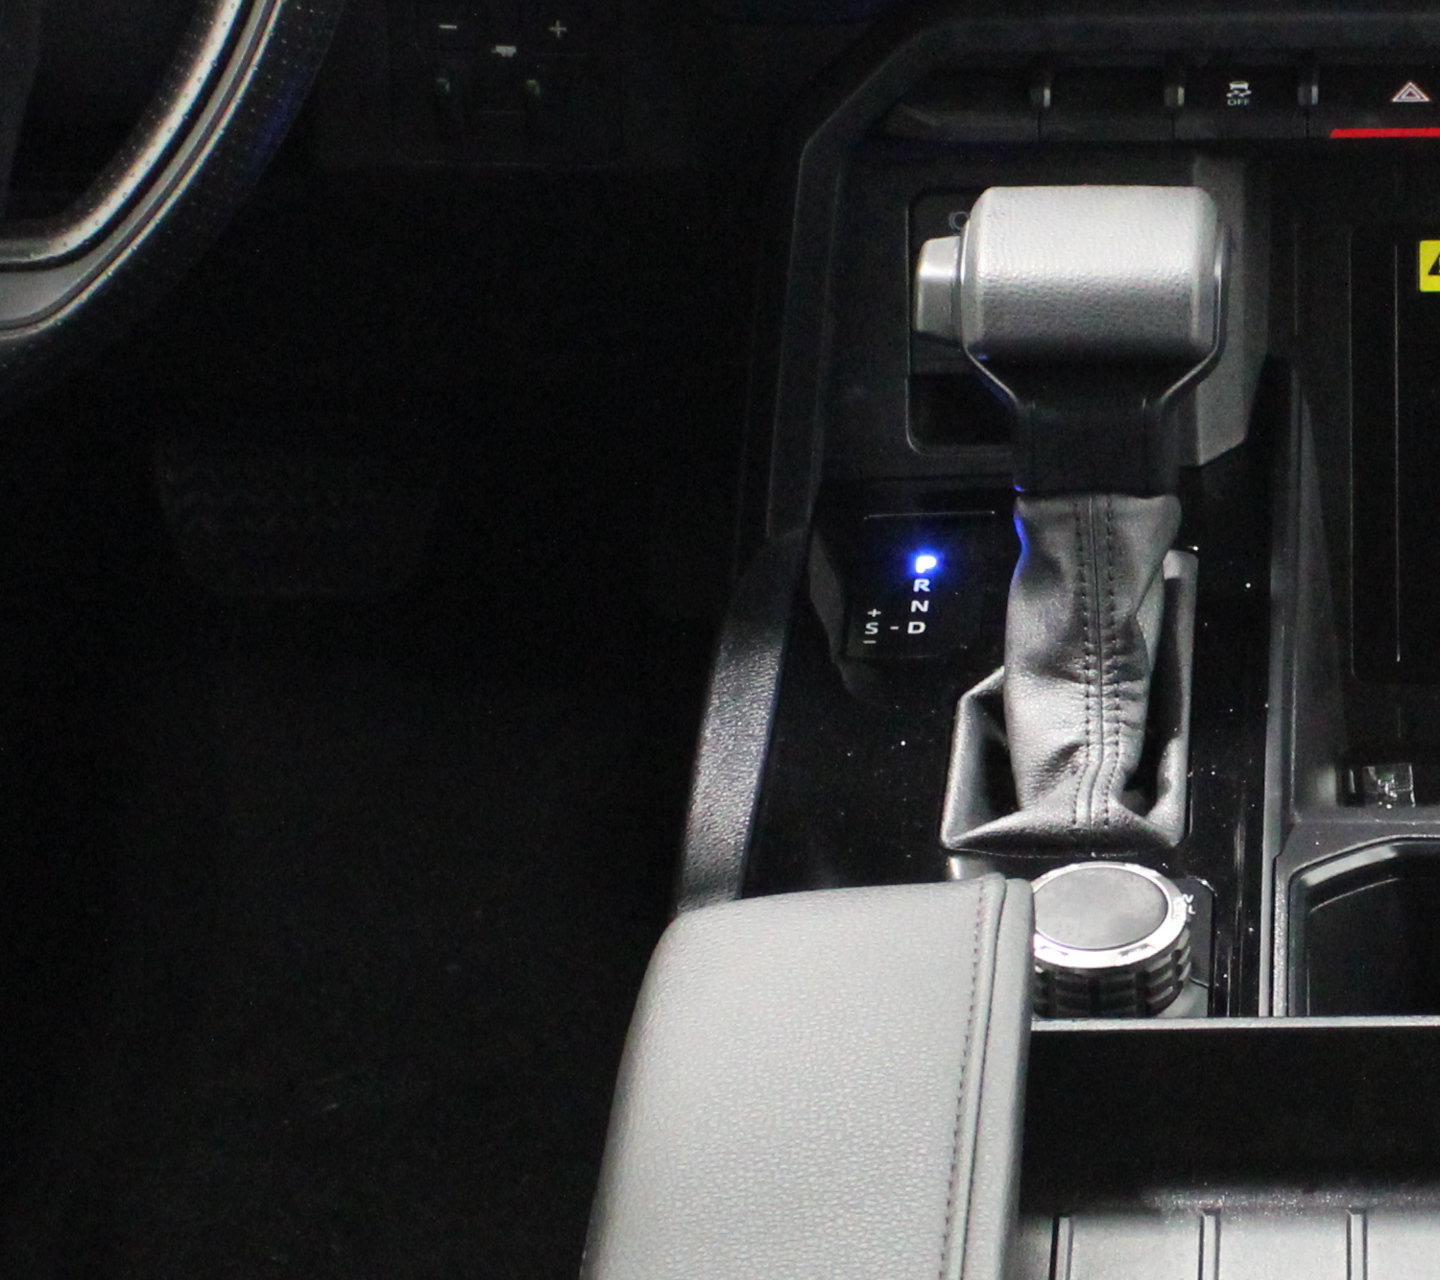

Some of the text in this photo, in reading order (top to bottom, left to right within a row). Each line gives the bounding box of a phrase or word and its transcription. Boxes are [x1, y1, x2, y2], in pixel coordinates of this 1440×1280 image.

[915, 555, 937, 574] P
[913, 578, 930, 592] R
[910, 600, 930, 613] N
[907, 621, 926, 634] D
